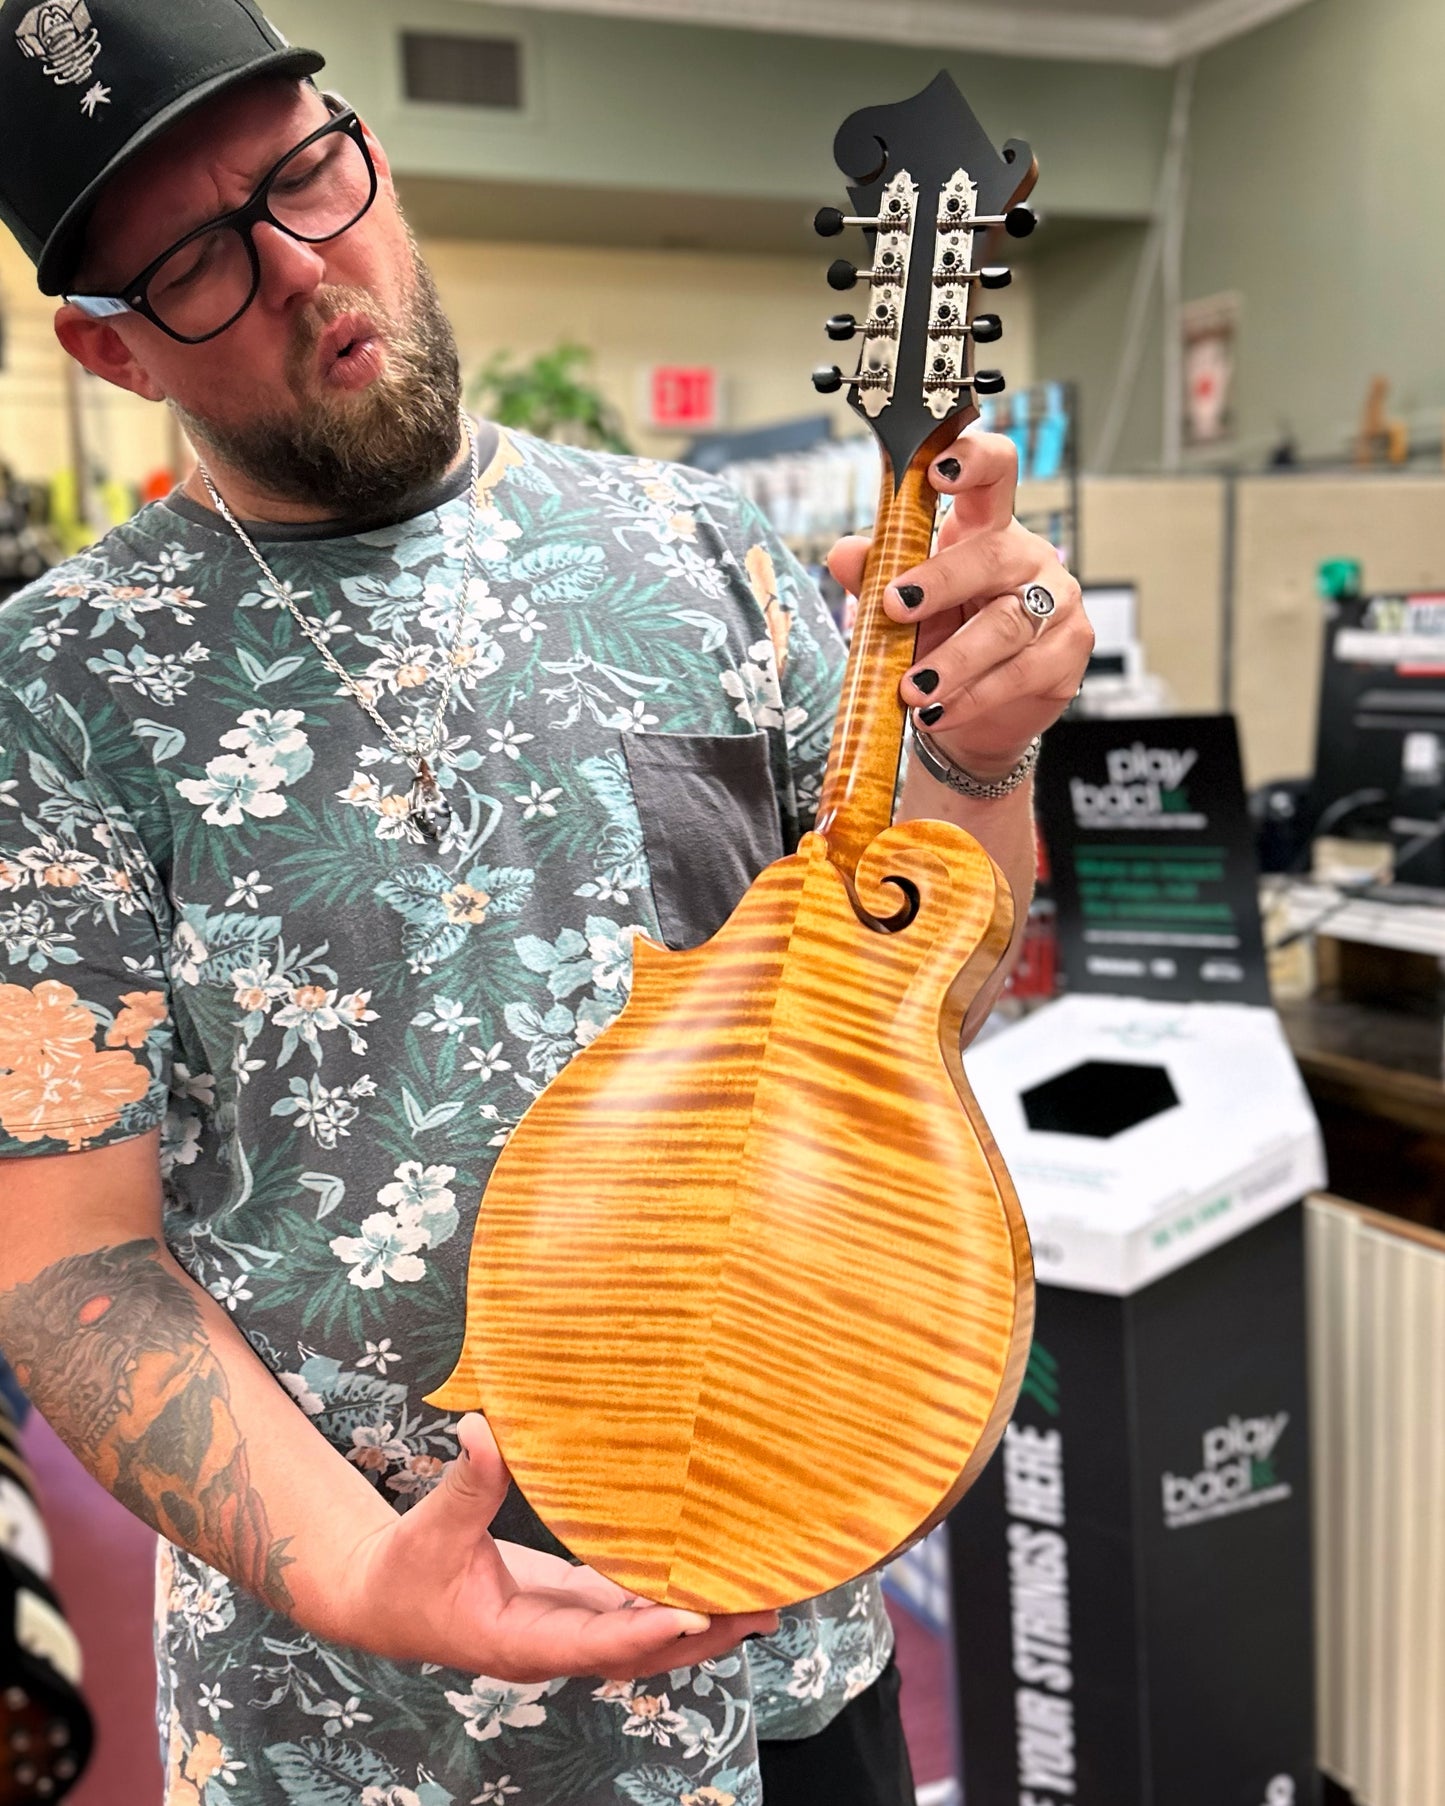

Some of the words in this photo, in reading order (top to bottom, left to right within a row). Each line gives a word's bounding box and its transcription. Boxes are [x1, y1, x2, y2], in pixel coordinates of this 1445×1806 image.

[1106, 741, 1198, 790] play
[1003, 1420, 1065, 1527] HERE
[1203, 1411, 1290, 1471] play
[1006, 1523, 1073, 1692] STRINGS
[1016, 1688, 1076, 1795] YOUR
